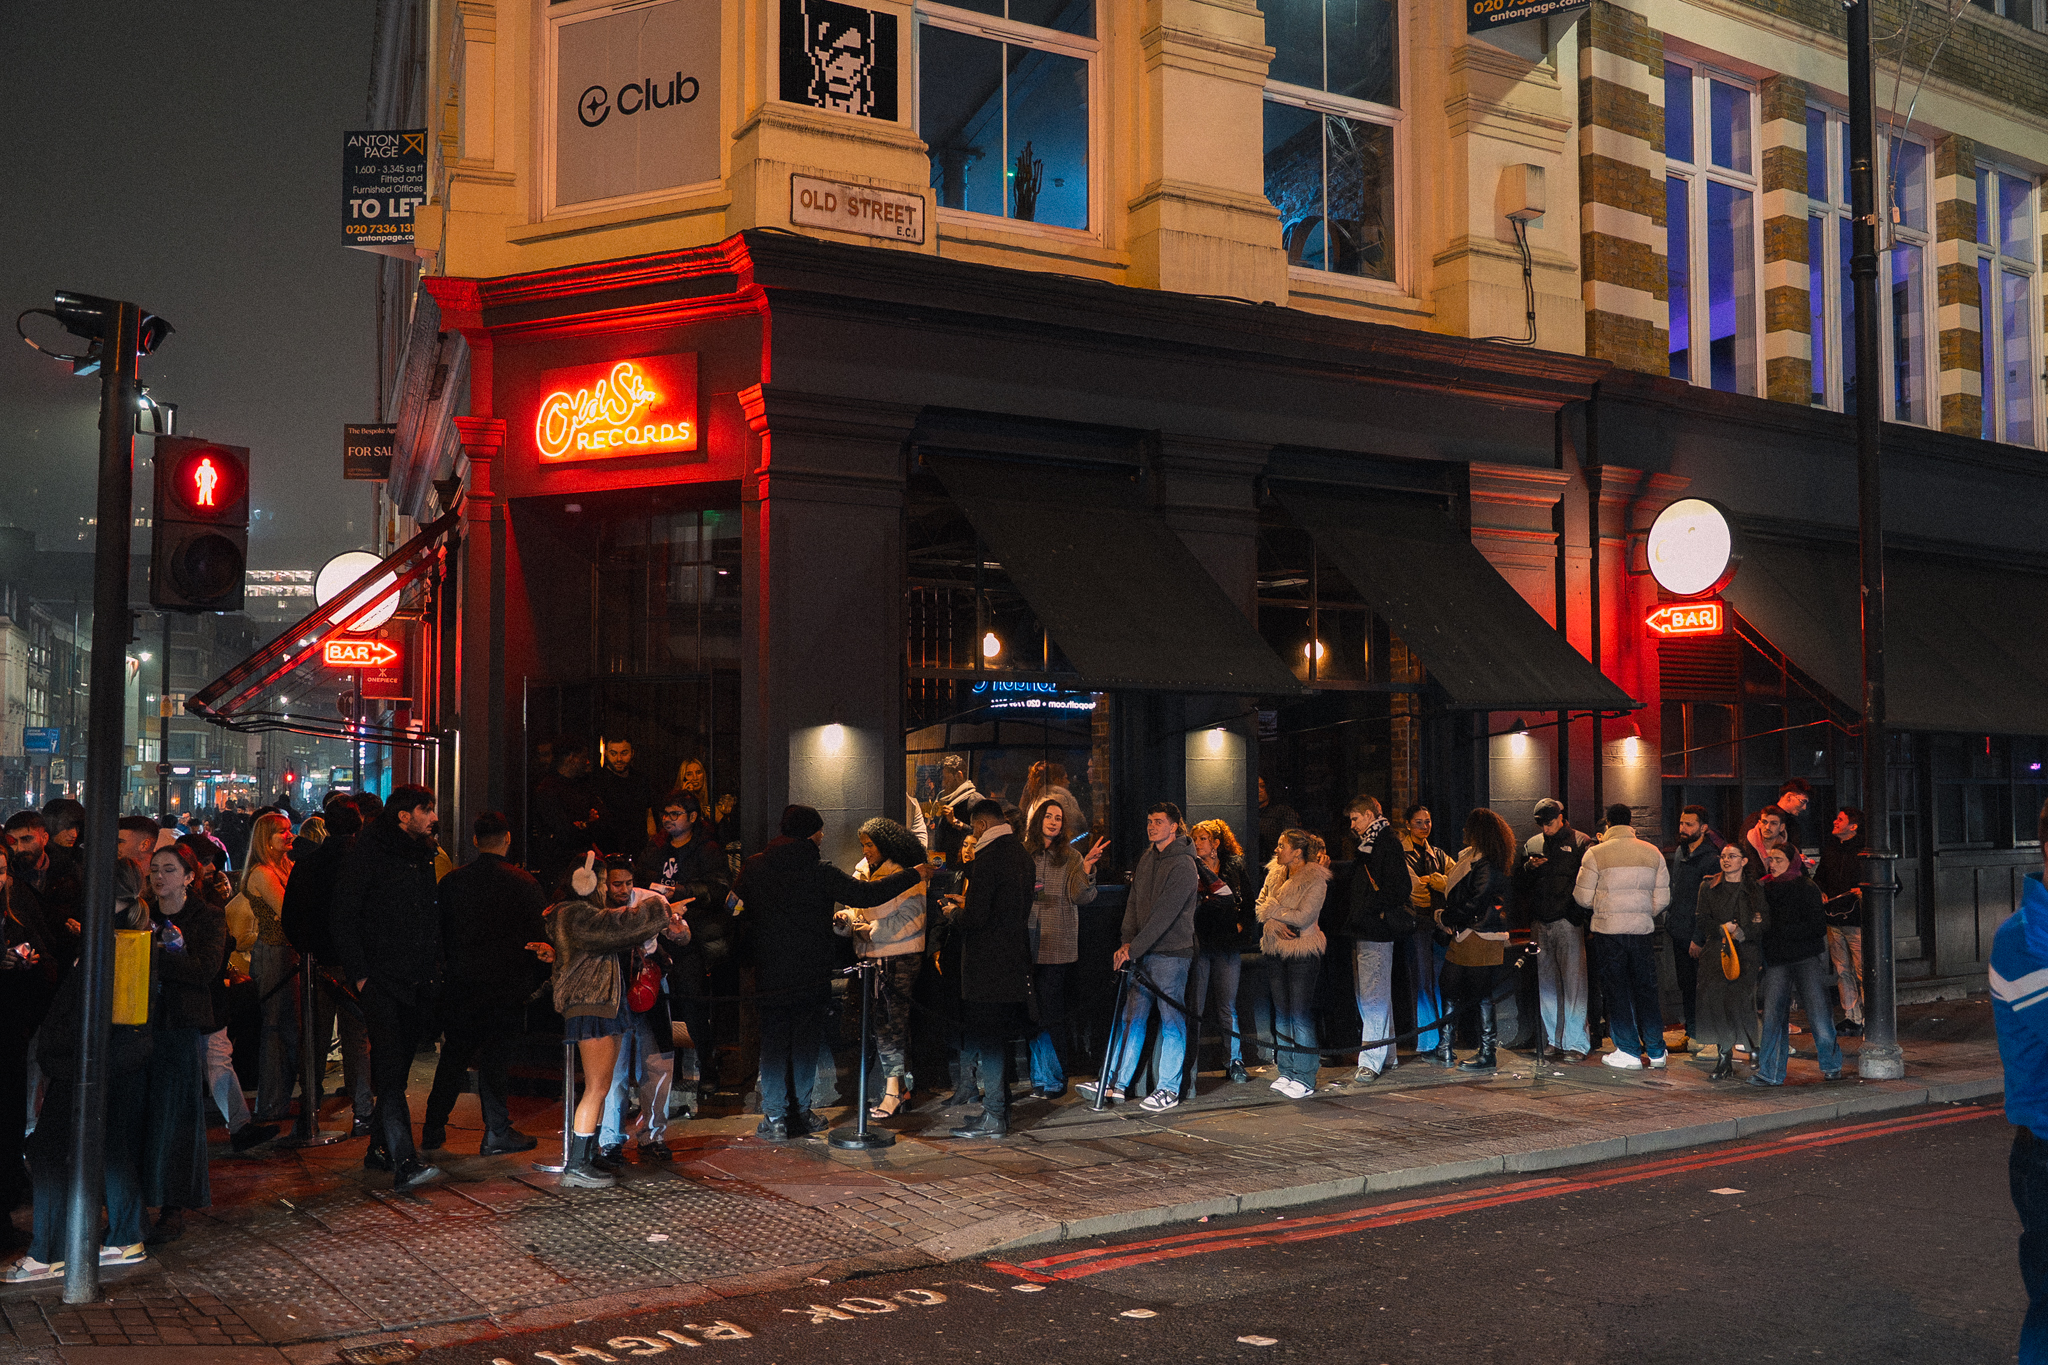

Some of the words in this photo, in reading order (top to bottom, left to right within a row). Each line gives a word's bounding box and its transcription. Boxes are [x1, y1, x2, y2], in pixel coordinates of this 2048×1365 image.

[1490, 0, 1586, 22] antonpage.com
[617, 71, 699, 115] Club
[347, 134, 399, 147] ANTON
[364, 146, 399, 158] PAGE
[355, 165, 376, 174] 1,600
[382, 164, 405, 174] 3,345
[417, 164, 424, 172] ft
[381, 174, 405, 183] Fitted
[406, 174, 423, 183] and
[352, 185, 392, 194] Furnished
[393, 184, 423, 193] Offices
[349, 198, 381, 219] TO
[388, 197, 423, 217] LET
[800, 189, 837, 212] OLD
[847, 196, 916, 225] STREET
[346, 224, 368, 234] 020
[369, 224, 398, 233] 7336
[400, 223, 415, 233] 131
[357, 234, 415, 243] antonpage.co
[536, 379, 606, 457] Old
[348, 427, 361, 435] The
[361, 427, 386, 435] Bespoke
[577, 421, 690, 450] RECORDS
[348, 446, 372, 457] FOR
[373, 446, 394, 457] SAL
[1672, 611, 1713, 627] BAR
[329, 645, 369, 659] BAR
